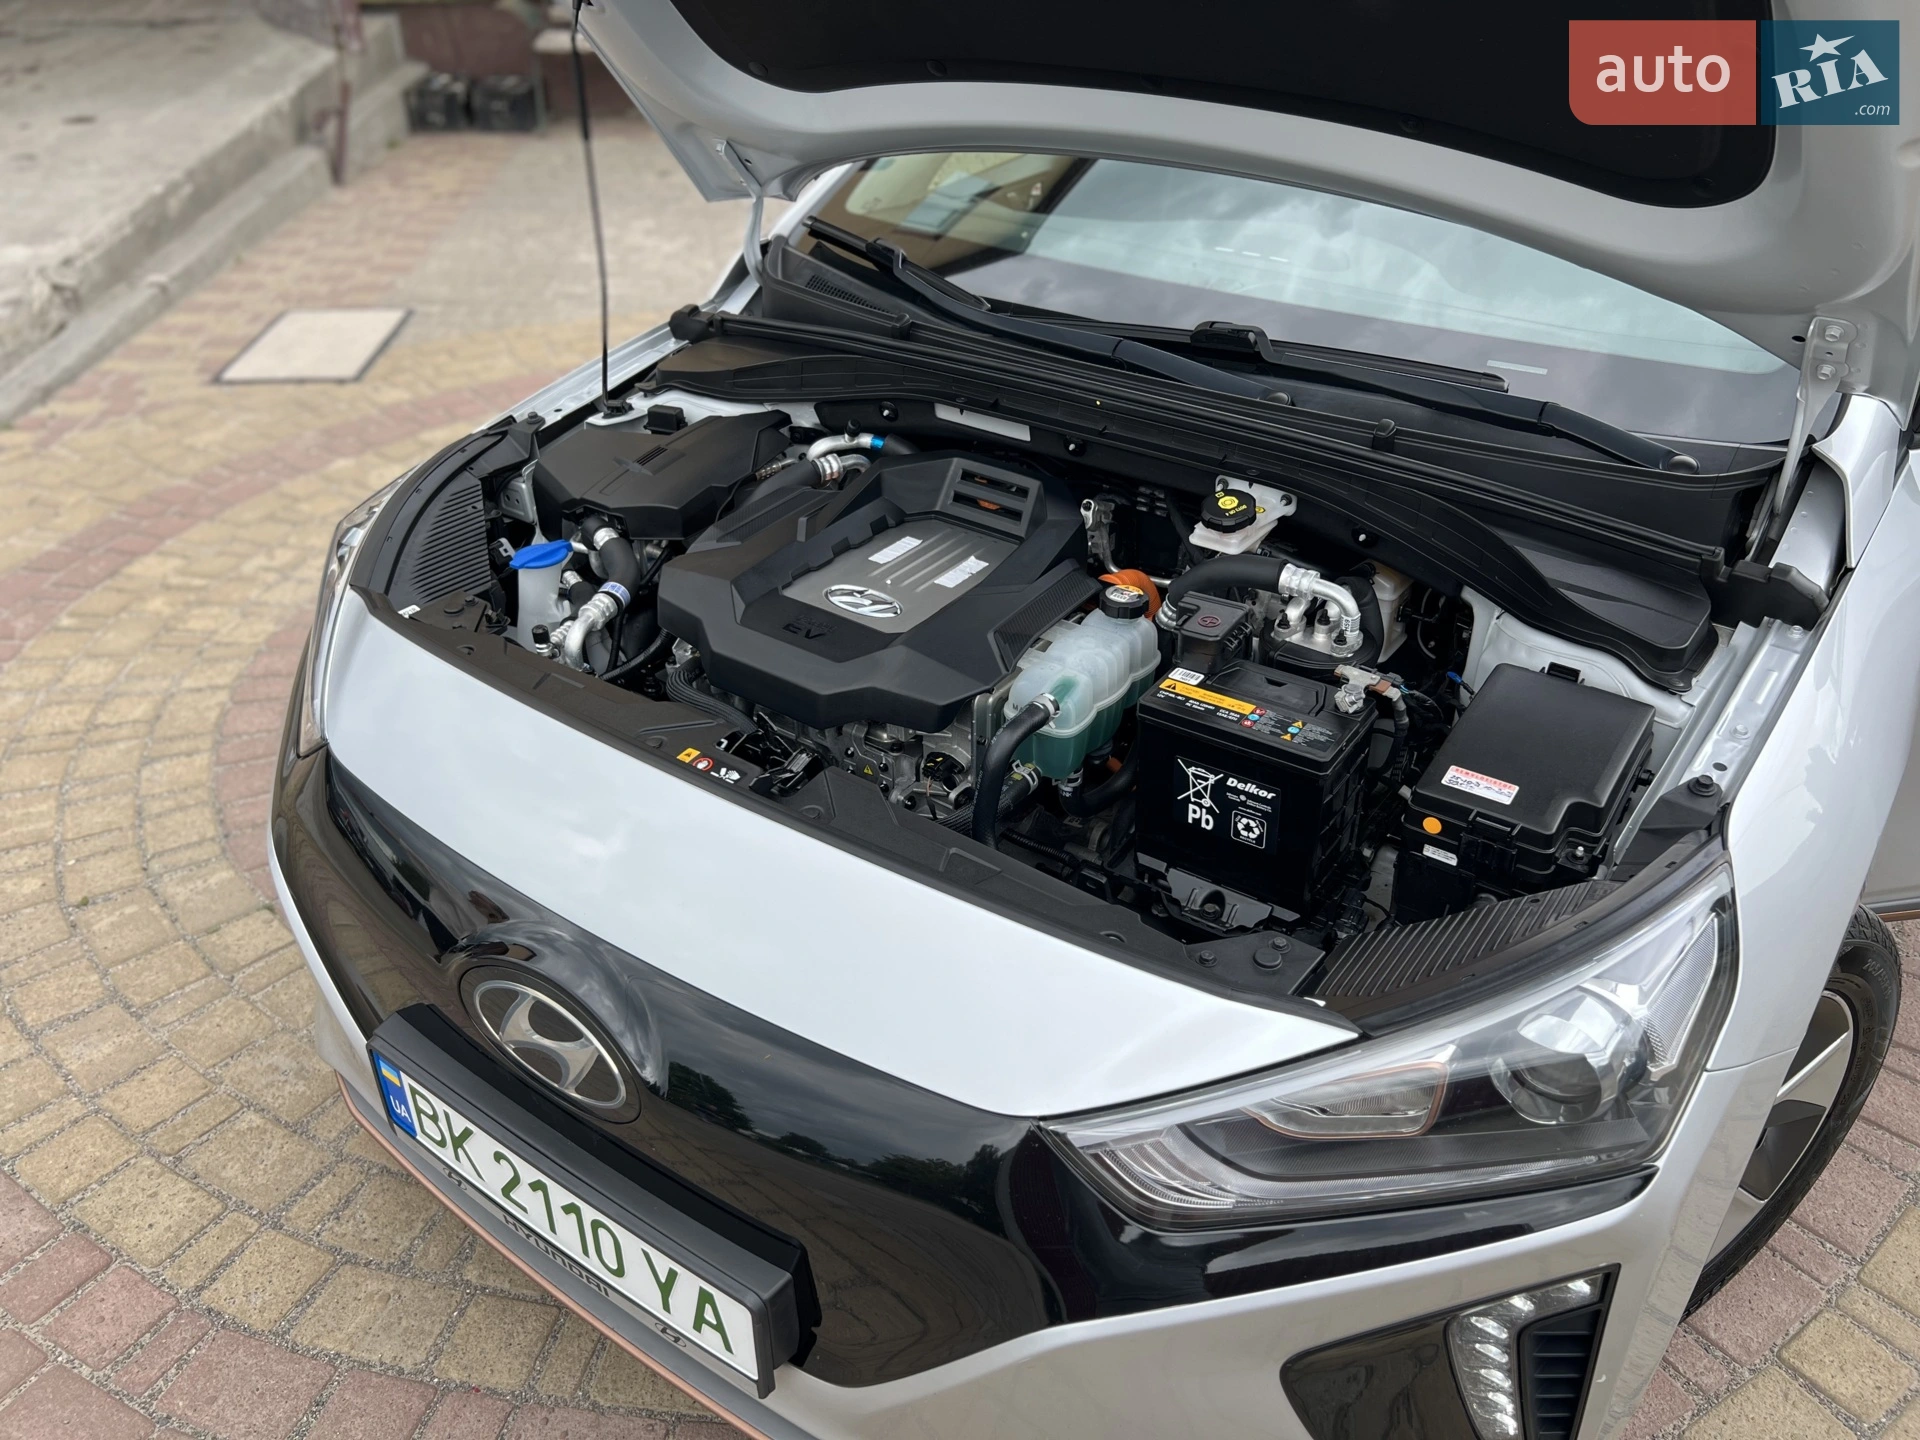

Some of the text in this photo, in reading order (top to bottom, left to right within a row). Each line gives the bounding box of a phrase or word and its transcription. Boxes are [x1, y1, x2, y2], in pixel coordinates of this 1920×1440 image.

[782, 623, 826, 640] EV
[1226, 777, 1277, 800] Delkor
[1187, 803, 1215, 831] Pb
[389, 1094, 412, 1123] UA
[408, 1084, 736, 1356] BK 2110 YA
[503, 1214, 610, 1298] HYUNDAI
